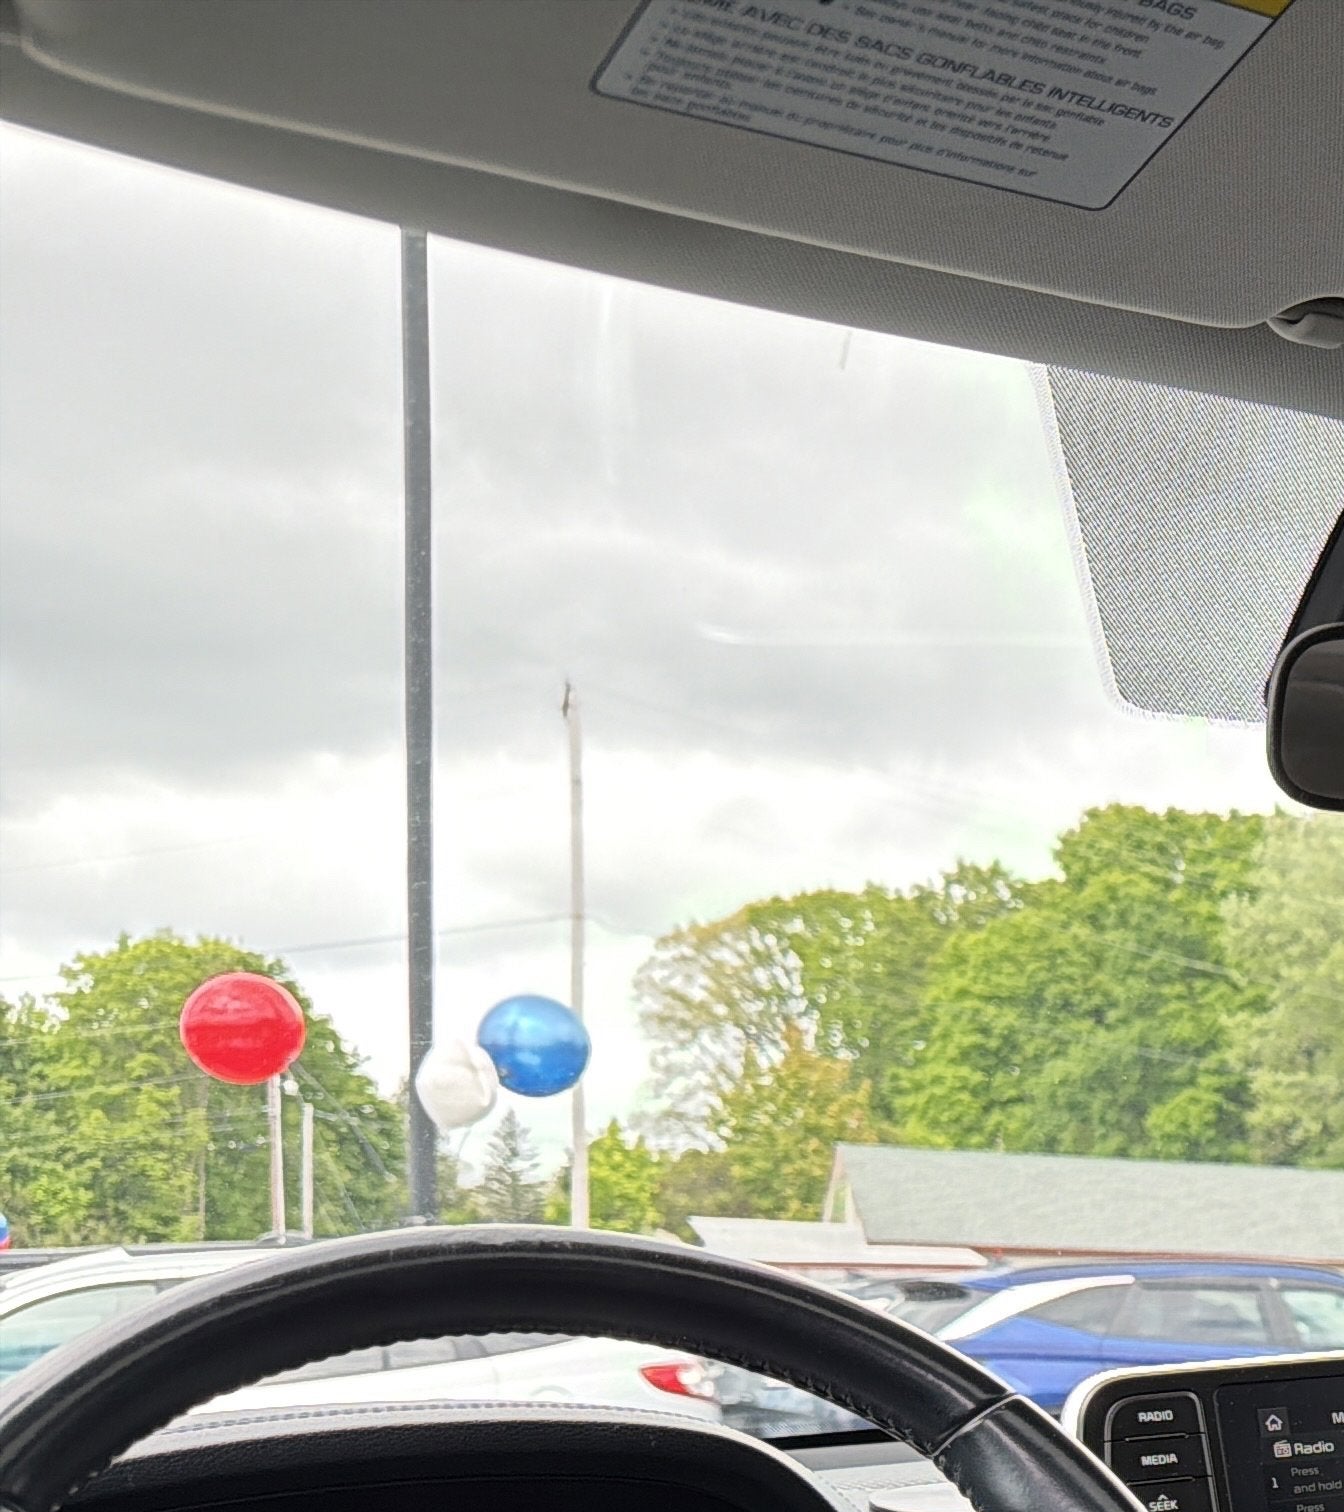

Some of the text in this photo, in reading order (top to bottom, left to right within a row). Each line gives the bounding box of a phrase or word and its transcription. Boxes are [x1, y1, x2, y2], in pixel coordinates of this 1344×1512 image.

[741, 5, 806, 30] AVEC
[804, 22, 854, 44] DES
[851, 35, 915, 61] SACS
[912, 51, 1048, 95] GONFLABLES
[1045, 85, 1178, 129] INTELLIGENTS
[1138, 1410, 1174, 1422] RADIO
[1293, 1441, 1335, 1454] Radio
[1141, 1453, 1178, 1466] MEDIA
[1290, 1465, 1320, 1477] Press
[1271, 1477, 1280, 1489] 1
[1293, 1479, 1342, 1494] and hold
[1148, 1500, 1179, 1512] SEEK
